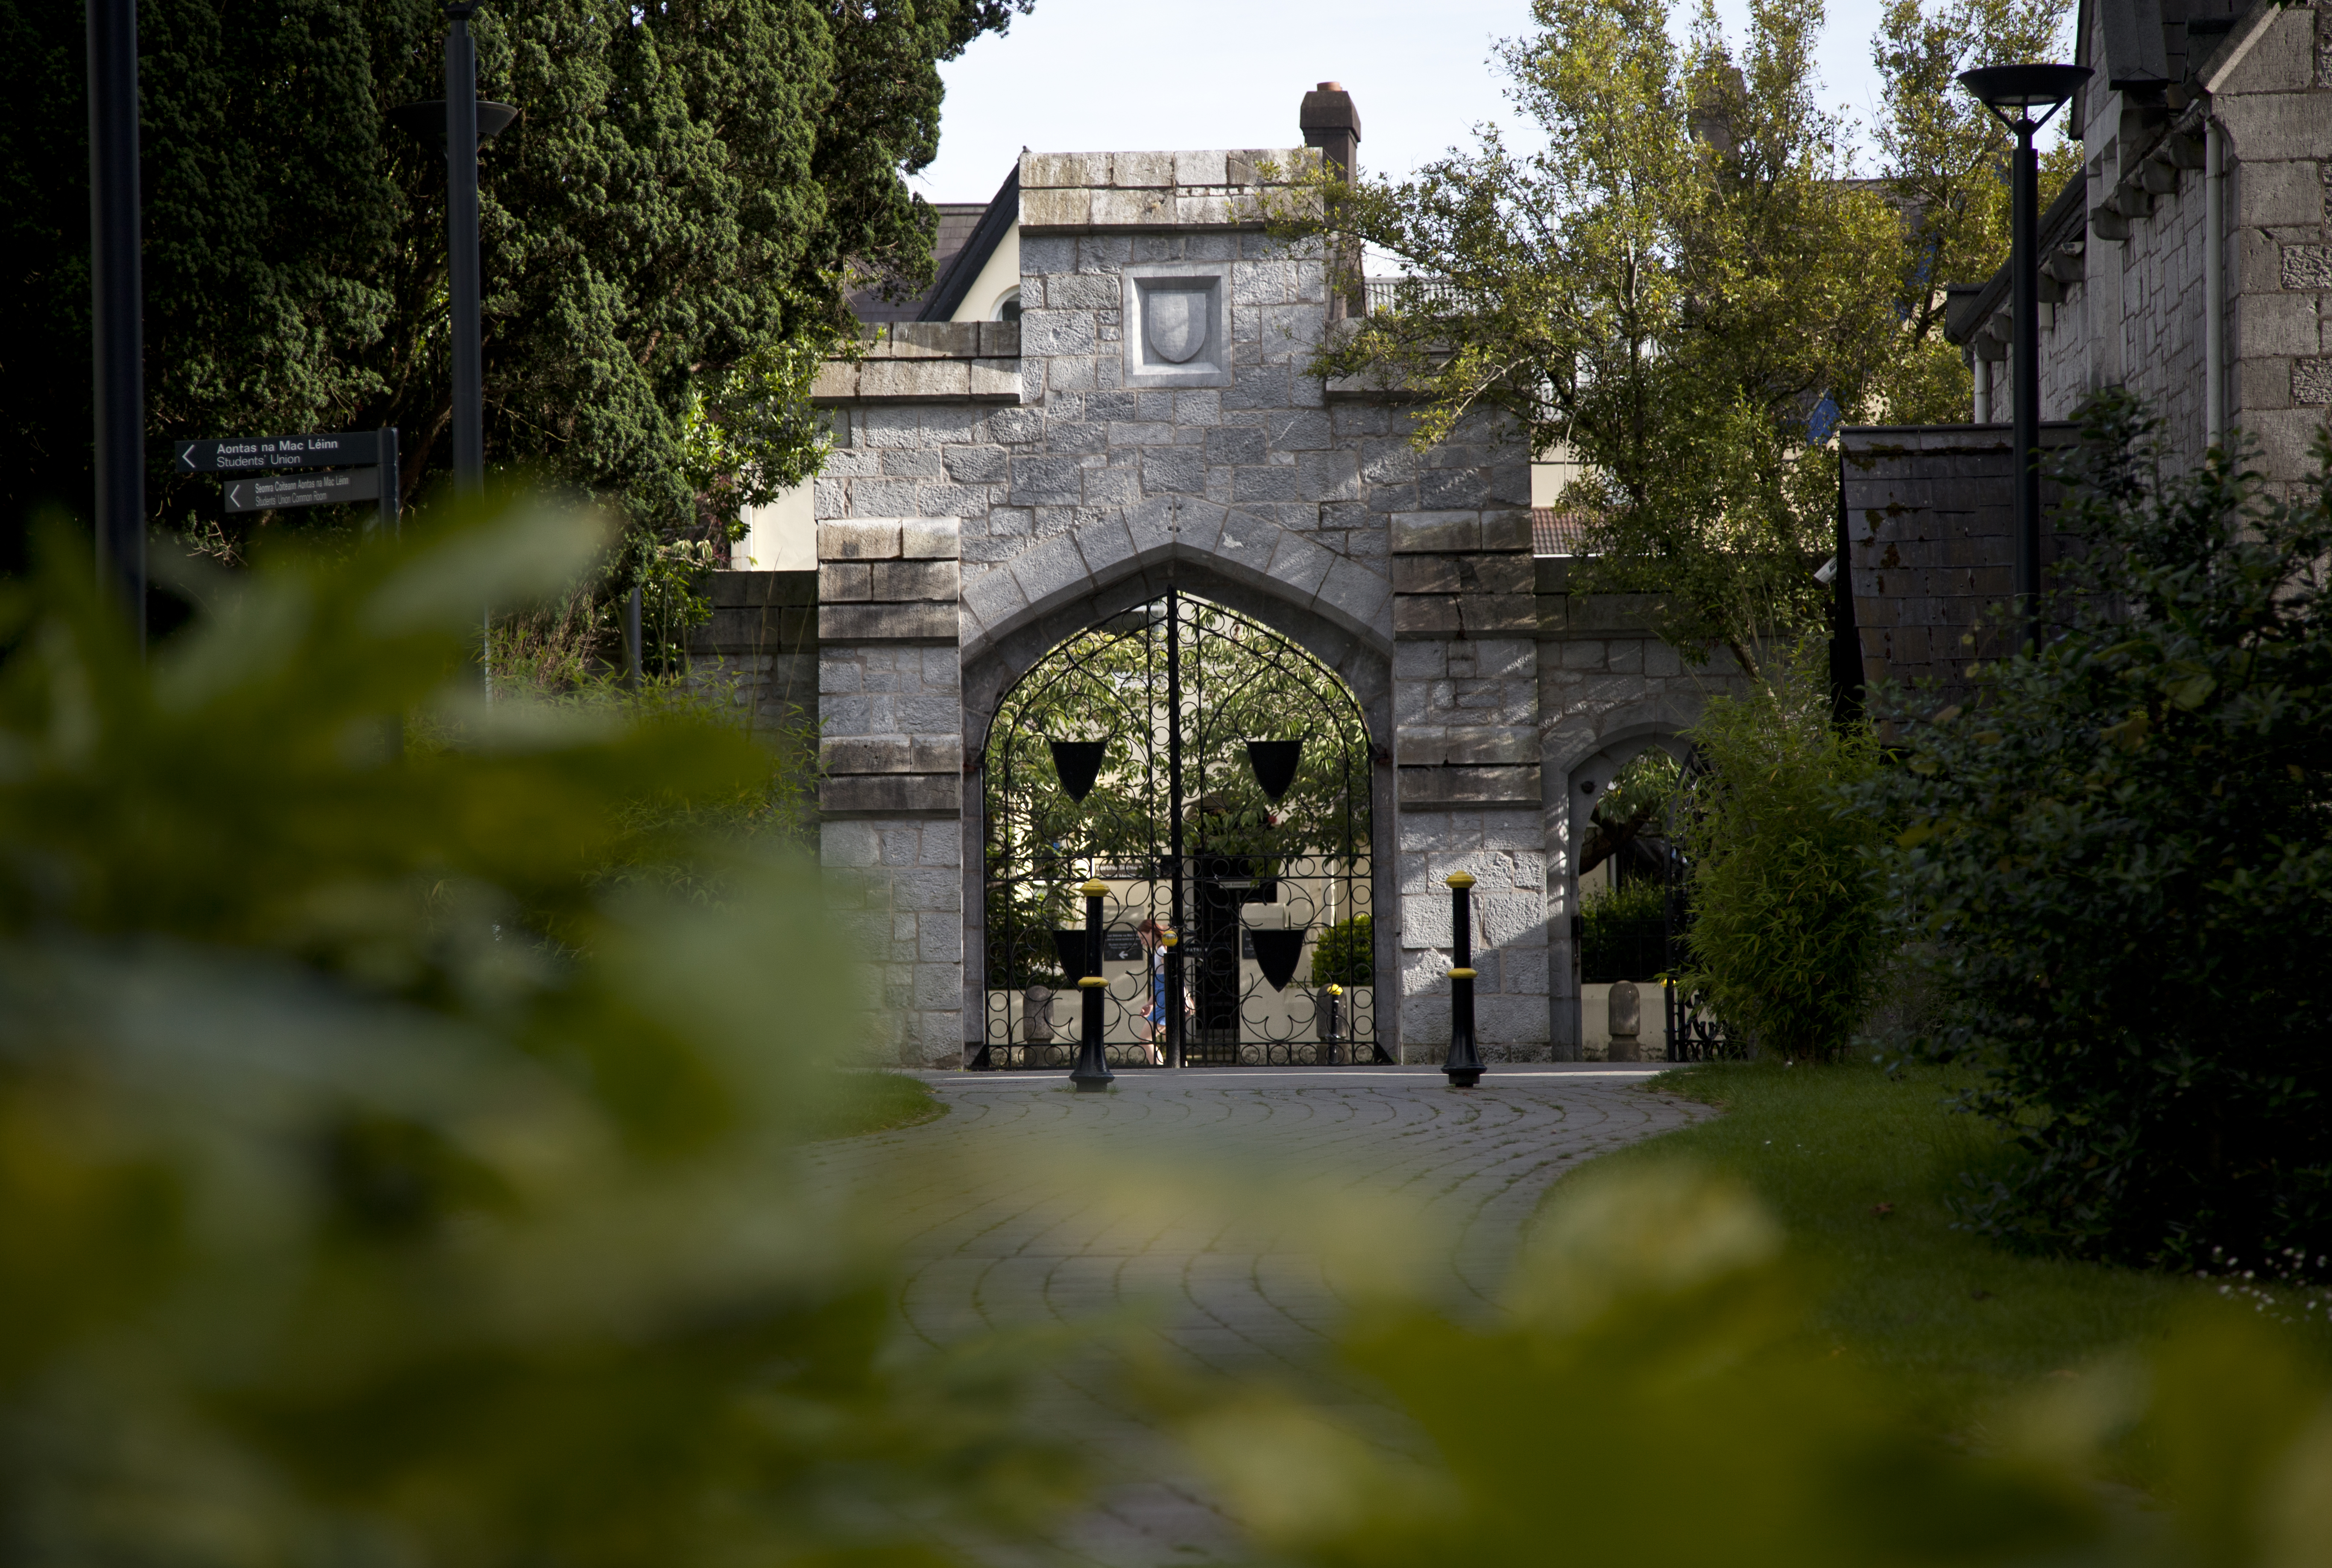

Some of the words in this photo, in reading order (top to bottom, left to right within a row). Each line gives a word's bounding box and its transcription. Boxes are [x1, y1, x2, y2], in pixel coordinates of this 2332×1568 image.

[217, 444, 257, 454] Aontas
[279, 440, 304, 451] Mac
[308, 439, 338, 449] Léinn
[217, 455, 266, 467] Students'
[271, 454, 300, 465] Union
[255, 483, 273, 493] Seomra
[275, 481, 296, 491] Coiteann
[298, 479, 314, 489] Aontas
[324, 477, 334, 486] Mac
[336, 475, 349, 485] Léinn
[255, 494, 276, 506] Students'
[278, 494, 290, 504] Union
[292, 492, 312, 503] Common
[313, 491, 327, 500] Room
